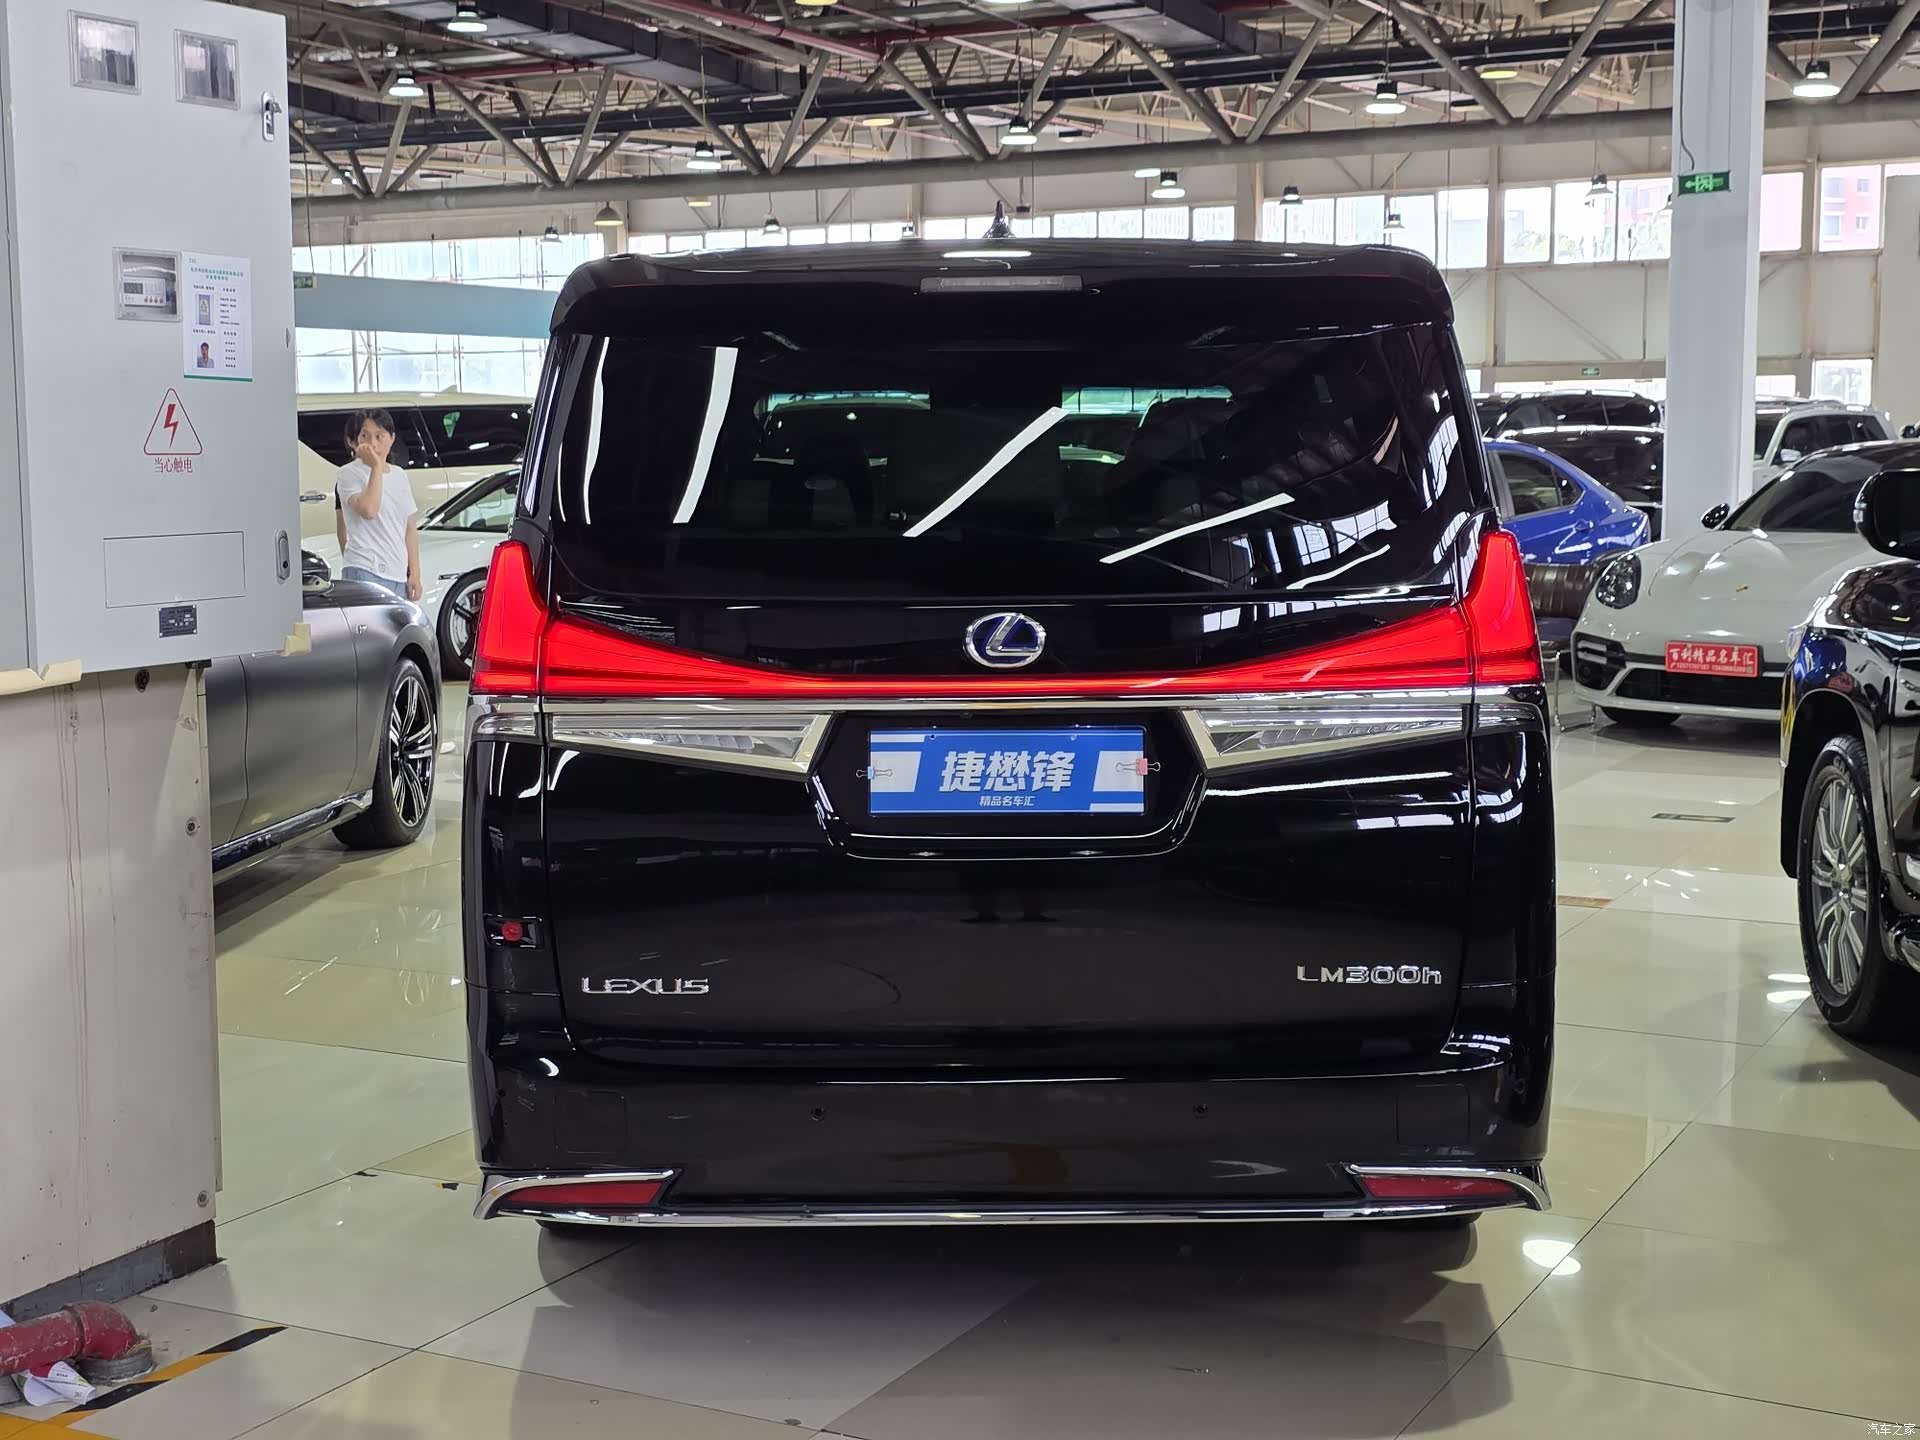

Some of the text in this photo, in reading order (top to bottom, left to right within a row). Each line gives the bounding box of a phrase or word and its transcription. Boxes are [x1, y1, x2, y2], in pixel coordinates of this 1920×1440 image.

[154, 456, 193, 473] 当心触电
[938, 750, 1076, 792] 捷懋锋
[979, 795, 1036, 807] 精品名车汇
[1296, 965, 1442, 985] LM300h
[580, 977, 710, 995] LEXUS
